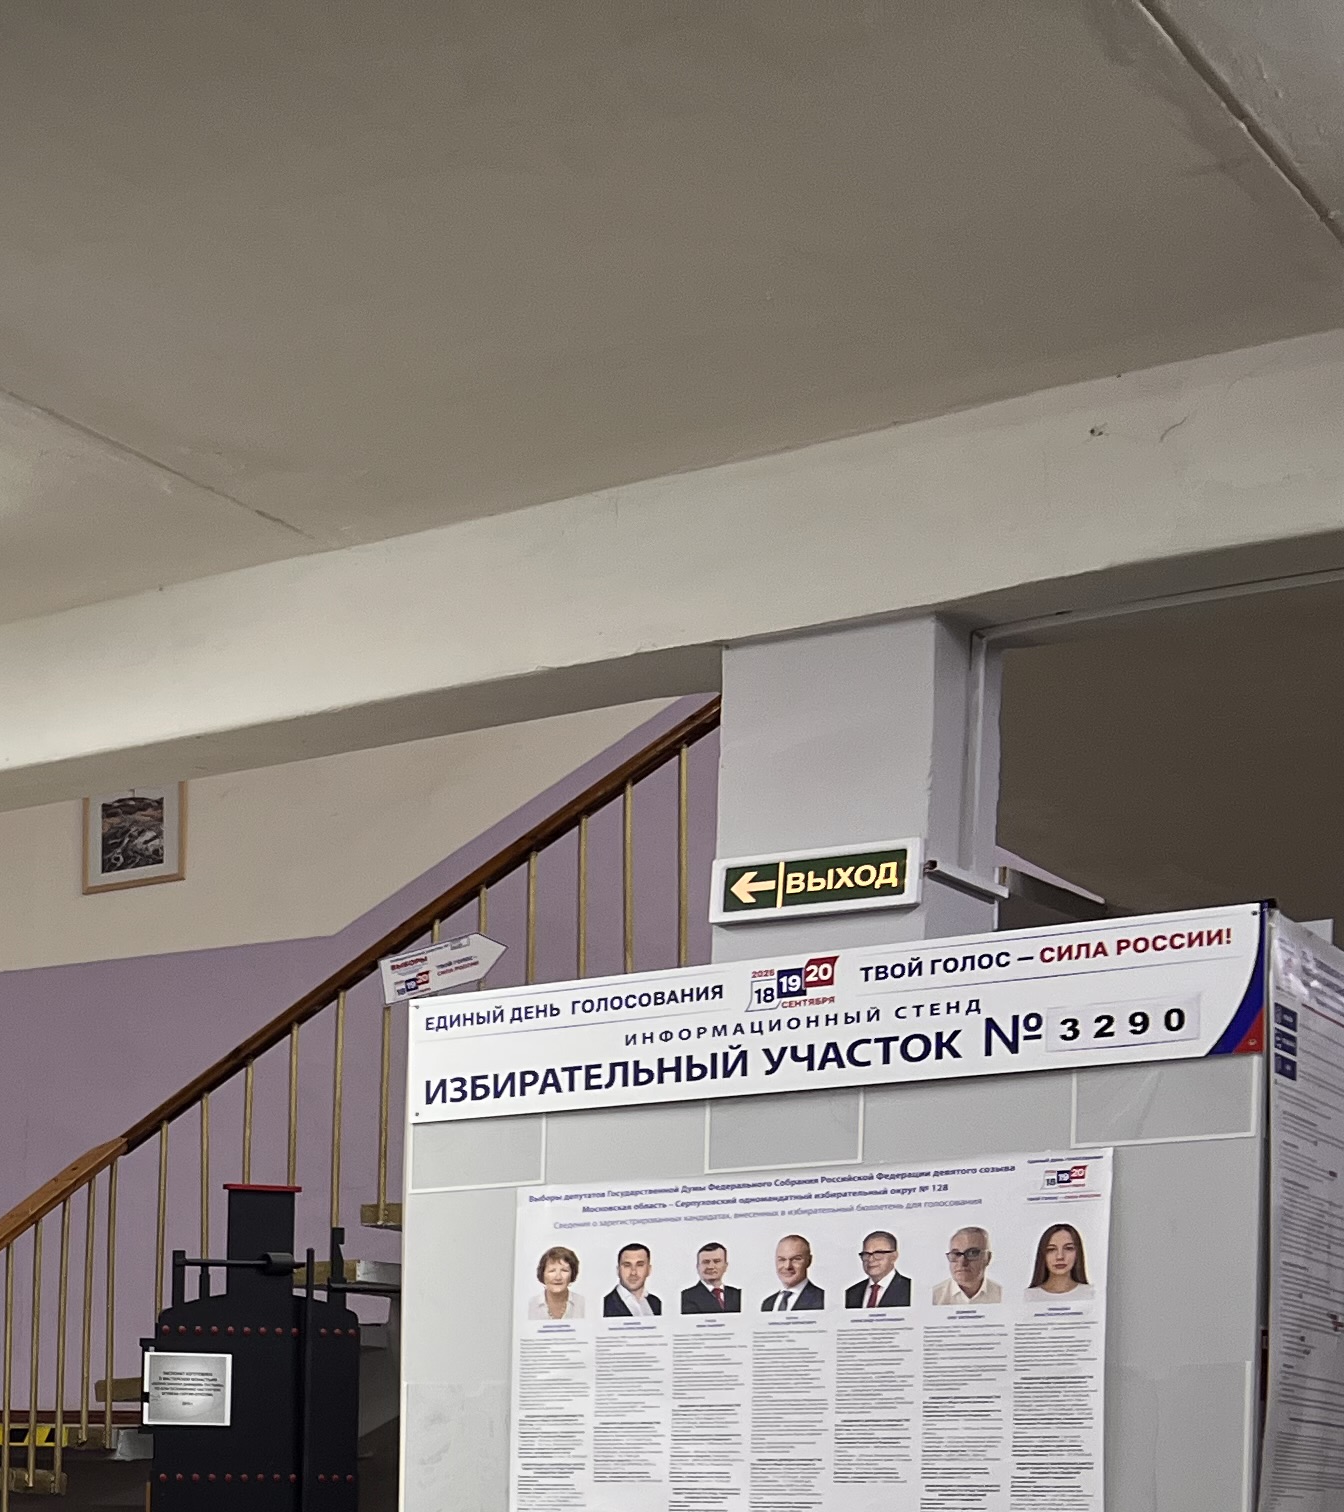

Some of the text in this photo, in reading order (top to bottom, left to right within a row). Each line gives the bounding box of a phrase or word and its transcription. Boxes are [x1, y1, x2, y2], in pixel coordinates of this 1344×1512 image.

[785, 861, 899, 894] ВЫХОД
[859, 957, 923, 982] ТВОЙ
[930, 951, 1011, 976] ГОЛОС
[1040, 941, 1109, 963] СИЛА
[1116, 928, 1232, 955] РОССИИ!
[754, 963, 833, 1004] 18 19 20
[781, 996, 836, 1009] СЕНТЯБРЯ
[425, 984, 724, 1032] ЕДИНЫЙ ДЕНЬ ГОЛОСОВАНИЯ
[624, 999, 982, 1046] ИНФОРМАЦИОННЫЙ СТЕНД
[424, 1008, 1186, 1105] ИЗБИРАТЕЛЬНЫЙ УЧАСТОК № 3290
[529, 1165, 1016, 1203] Выборы депутатов Государственной Думы Федерального Собрания Российской Федерации девятого созыва
[582, 1204, 632, 1213] Московская
[633, 1202, 667, 1210] область
[675, 1197, 736, 1208] Серпуховский
[739, 1193, 812, 1204] одномандатный
[814, 1187, 888, 1199] избирательный
[890, 1187, 917, 1196] округ
[931, 1184, 949, 1192] 128
[905, 1201, 923, 1210] для
[924, 1198, 983, 1209] голосования
